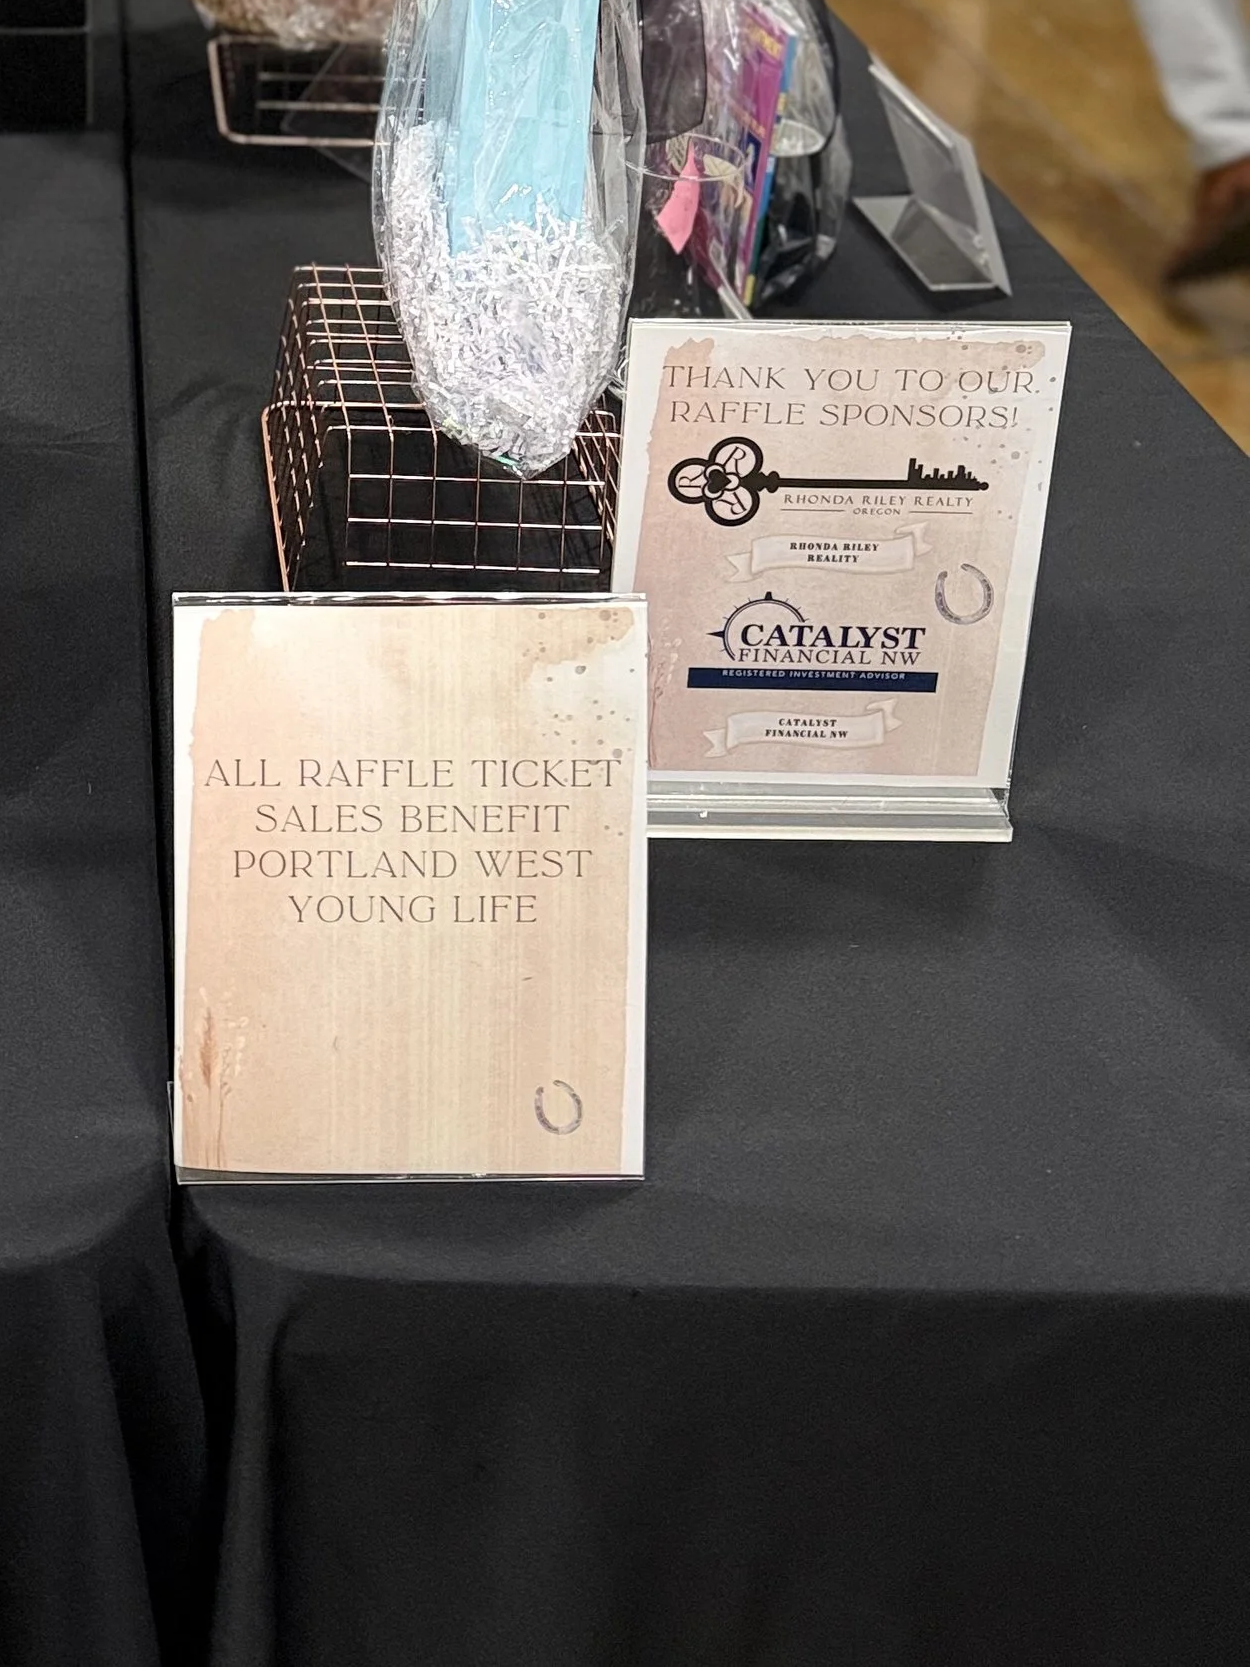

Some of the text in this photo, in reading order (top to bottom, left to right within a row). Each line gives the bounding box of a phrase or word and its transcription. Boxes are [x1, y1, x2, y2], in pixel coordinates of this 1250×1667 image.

[663, 365, 1034, 394] THANK YOU TO OUR
[670, 401, 1018, 428] RAFFLE SPONSORS!
[784, 493, 973, 507] RHONDA RILEY REALTY
[852, 507, 901, 516] OREGON
[790, 542, 880, 552] RHONDA RILEY
[807, 554, 859, 563] REALITY
[741, 624, 925, 650] CATALYST
[738, 648, 922, 666] FINANCIAL NW
[722, 669, 905, 680] REGISTERED INVESTMENT ADVISOR
[778, 718, 837, 727] CATALYST
[765, 729, 848, 739] FINANCIAL NW
[204, 759, 622, 787] ALL RAFFLE TICKET
[255, 805, 570, 833] SALES BENEFIT
[234, 850, 593, 878] PORTLAND WEST
[288, 895, 537, 923] YOUNG LIFE
